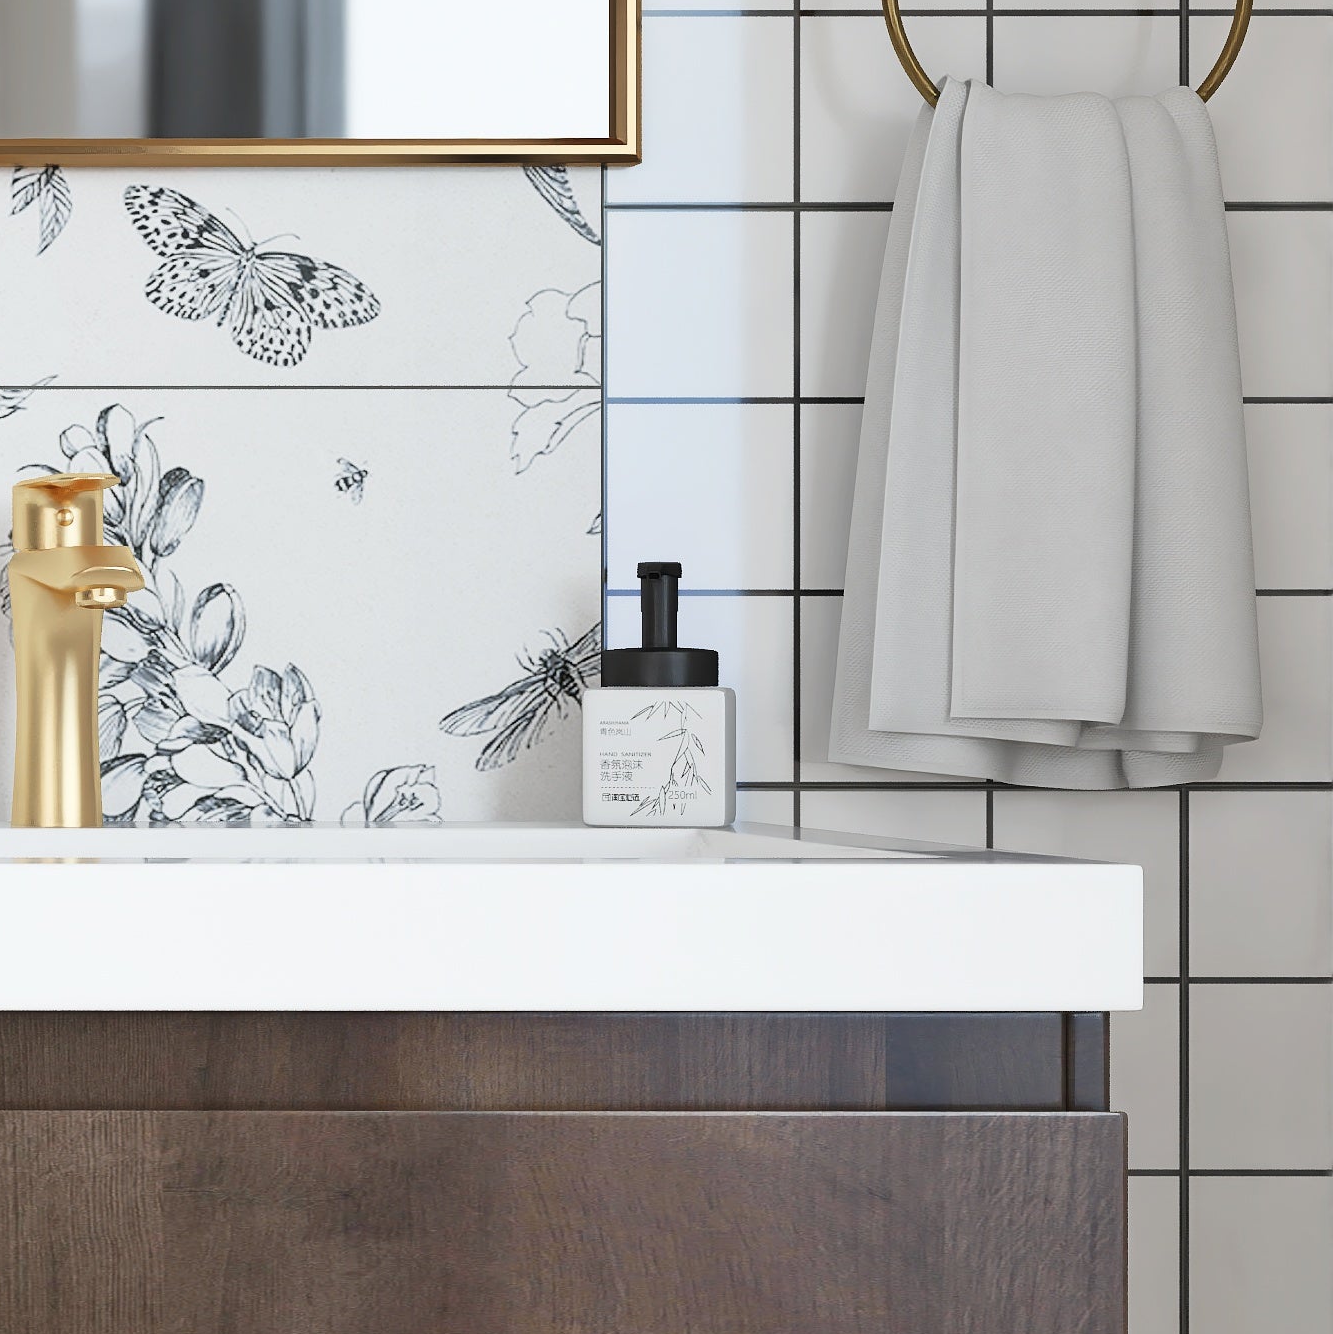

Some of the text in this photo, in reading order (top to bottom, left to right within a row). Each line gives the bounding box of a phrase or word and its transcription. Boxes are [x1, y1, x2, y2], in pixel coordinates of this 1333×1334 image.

[599, 759, 644, 770] 香氛泡沫
[599, 770, 633, 781] 洗手液
[668, 790, 698, 800] 250ml
